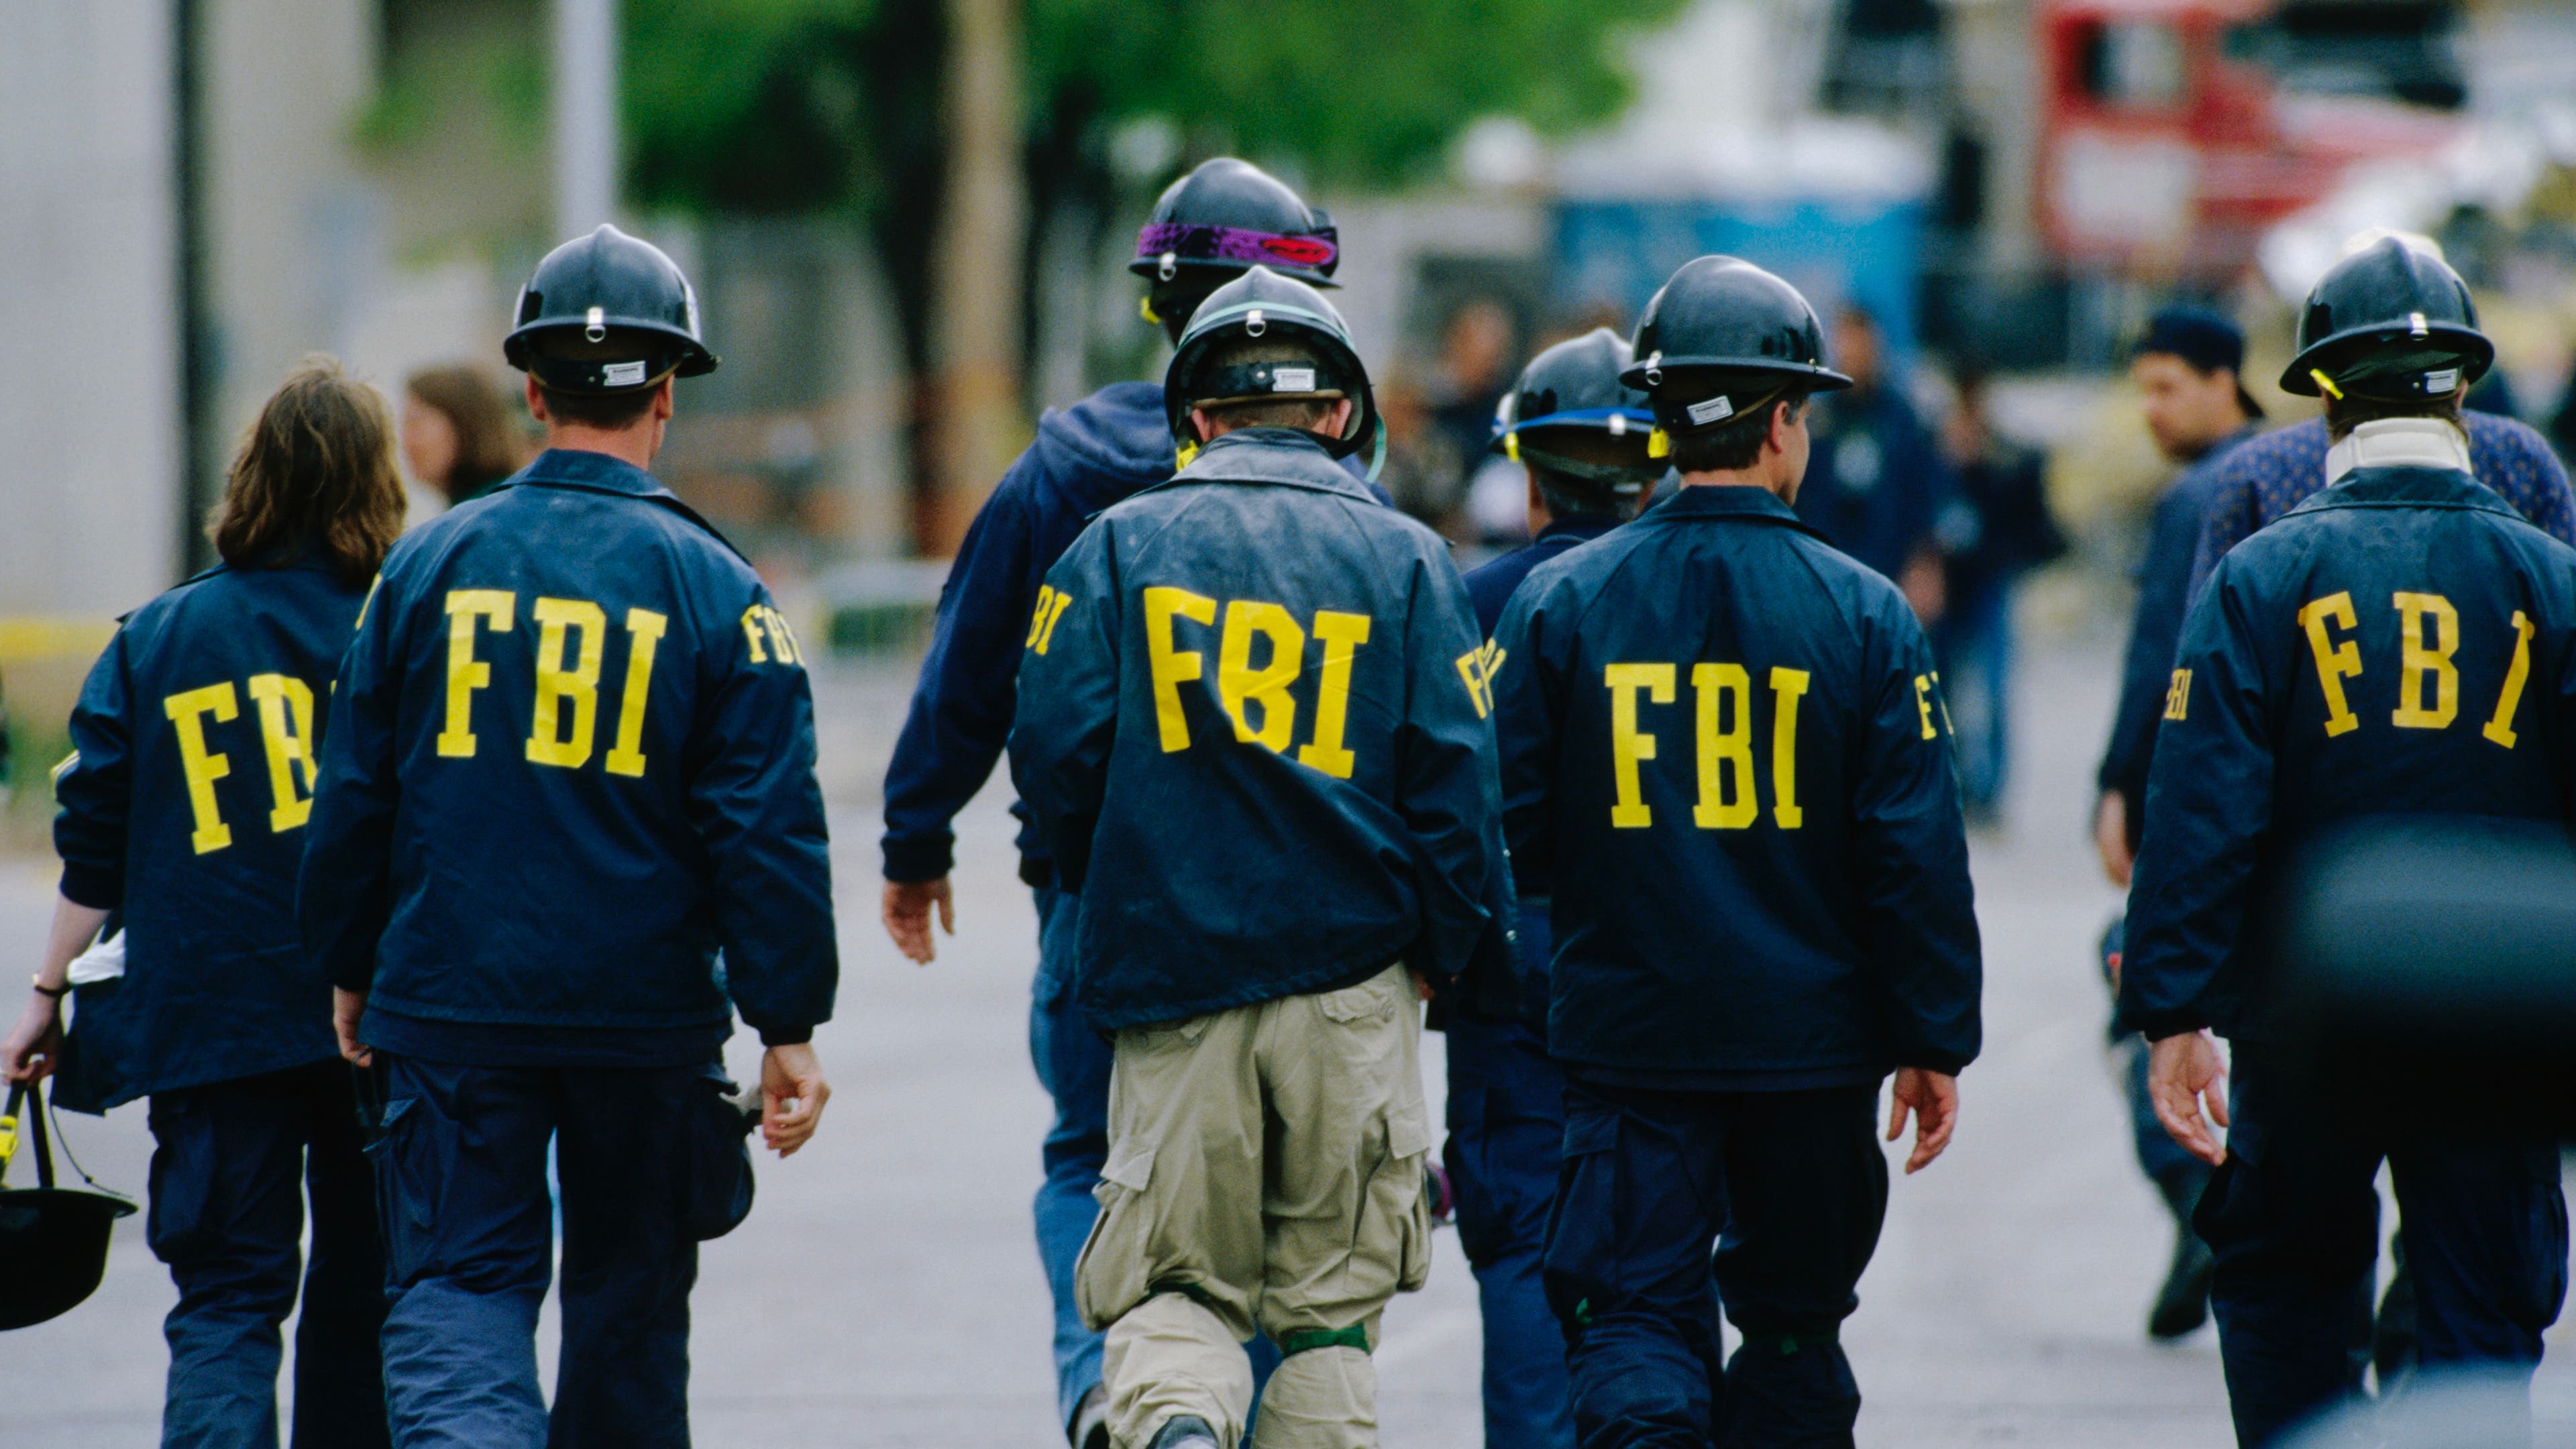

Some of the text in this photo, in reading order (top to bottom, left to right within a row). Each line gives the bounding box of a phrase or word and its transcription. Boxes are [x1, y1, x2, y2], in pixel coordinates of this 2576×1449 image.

[436, 588, 668, 777] FBI
[1142, 586, 1371, 780] FBI
[1604, 662, 1811, 829] FBI
[2163, 668, 2193, 720] BI
[2298, 590, 2536, 749] FBI
[163, 672, 337, 855] FB
